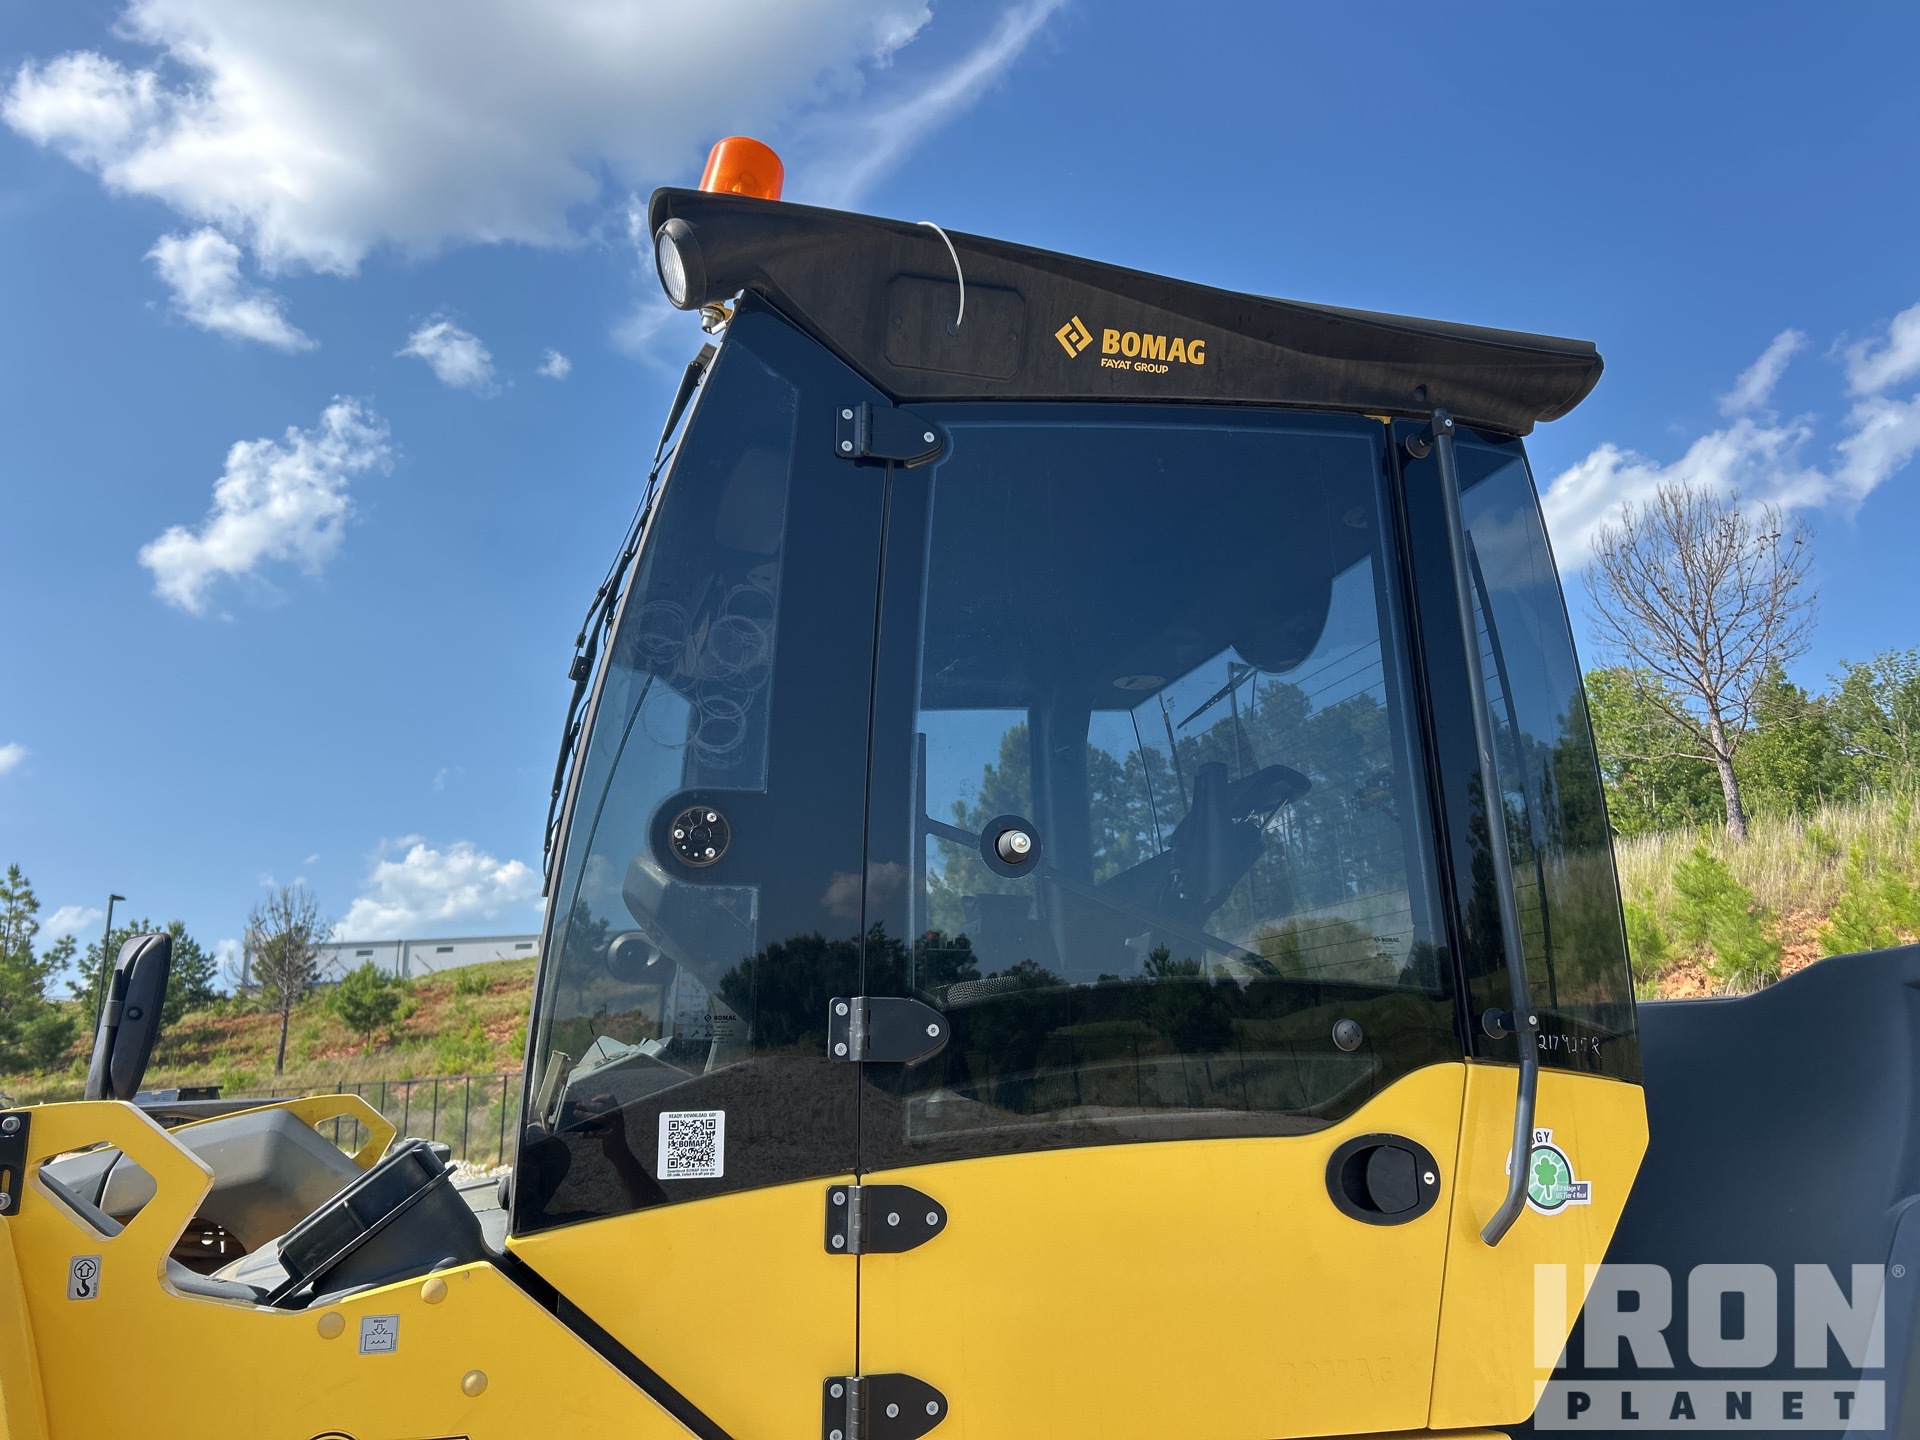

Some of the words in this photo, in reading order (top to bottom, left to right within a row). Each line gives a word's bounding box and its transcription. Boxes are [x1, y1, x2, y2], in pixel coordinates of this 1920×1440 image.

[1102, 329, 1205, 365] BOMAG
[1100, 358, 1132, 370] FAYAT
[1134, 361, 1169, 374] GROUP
